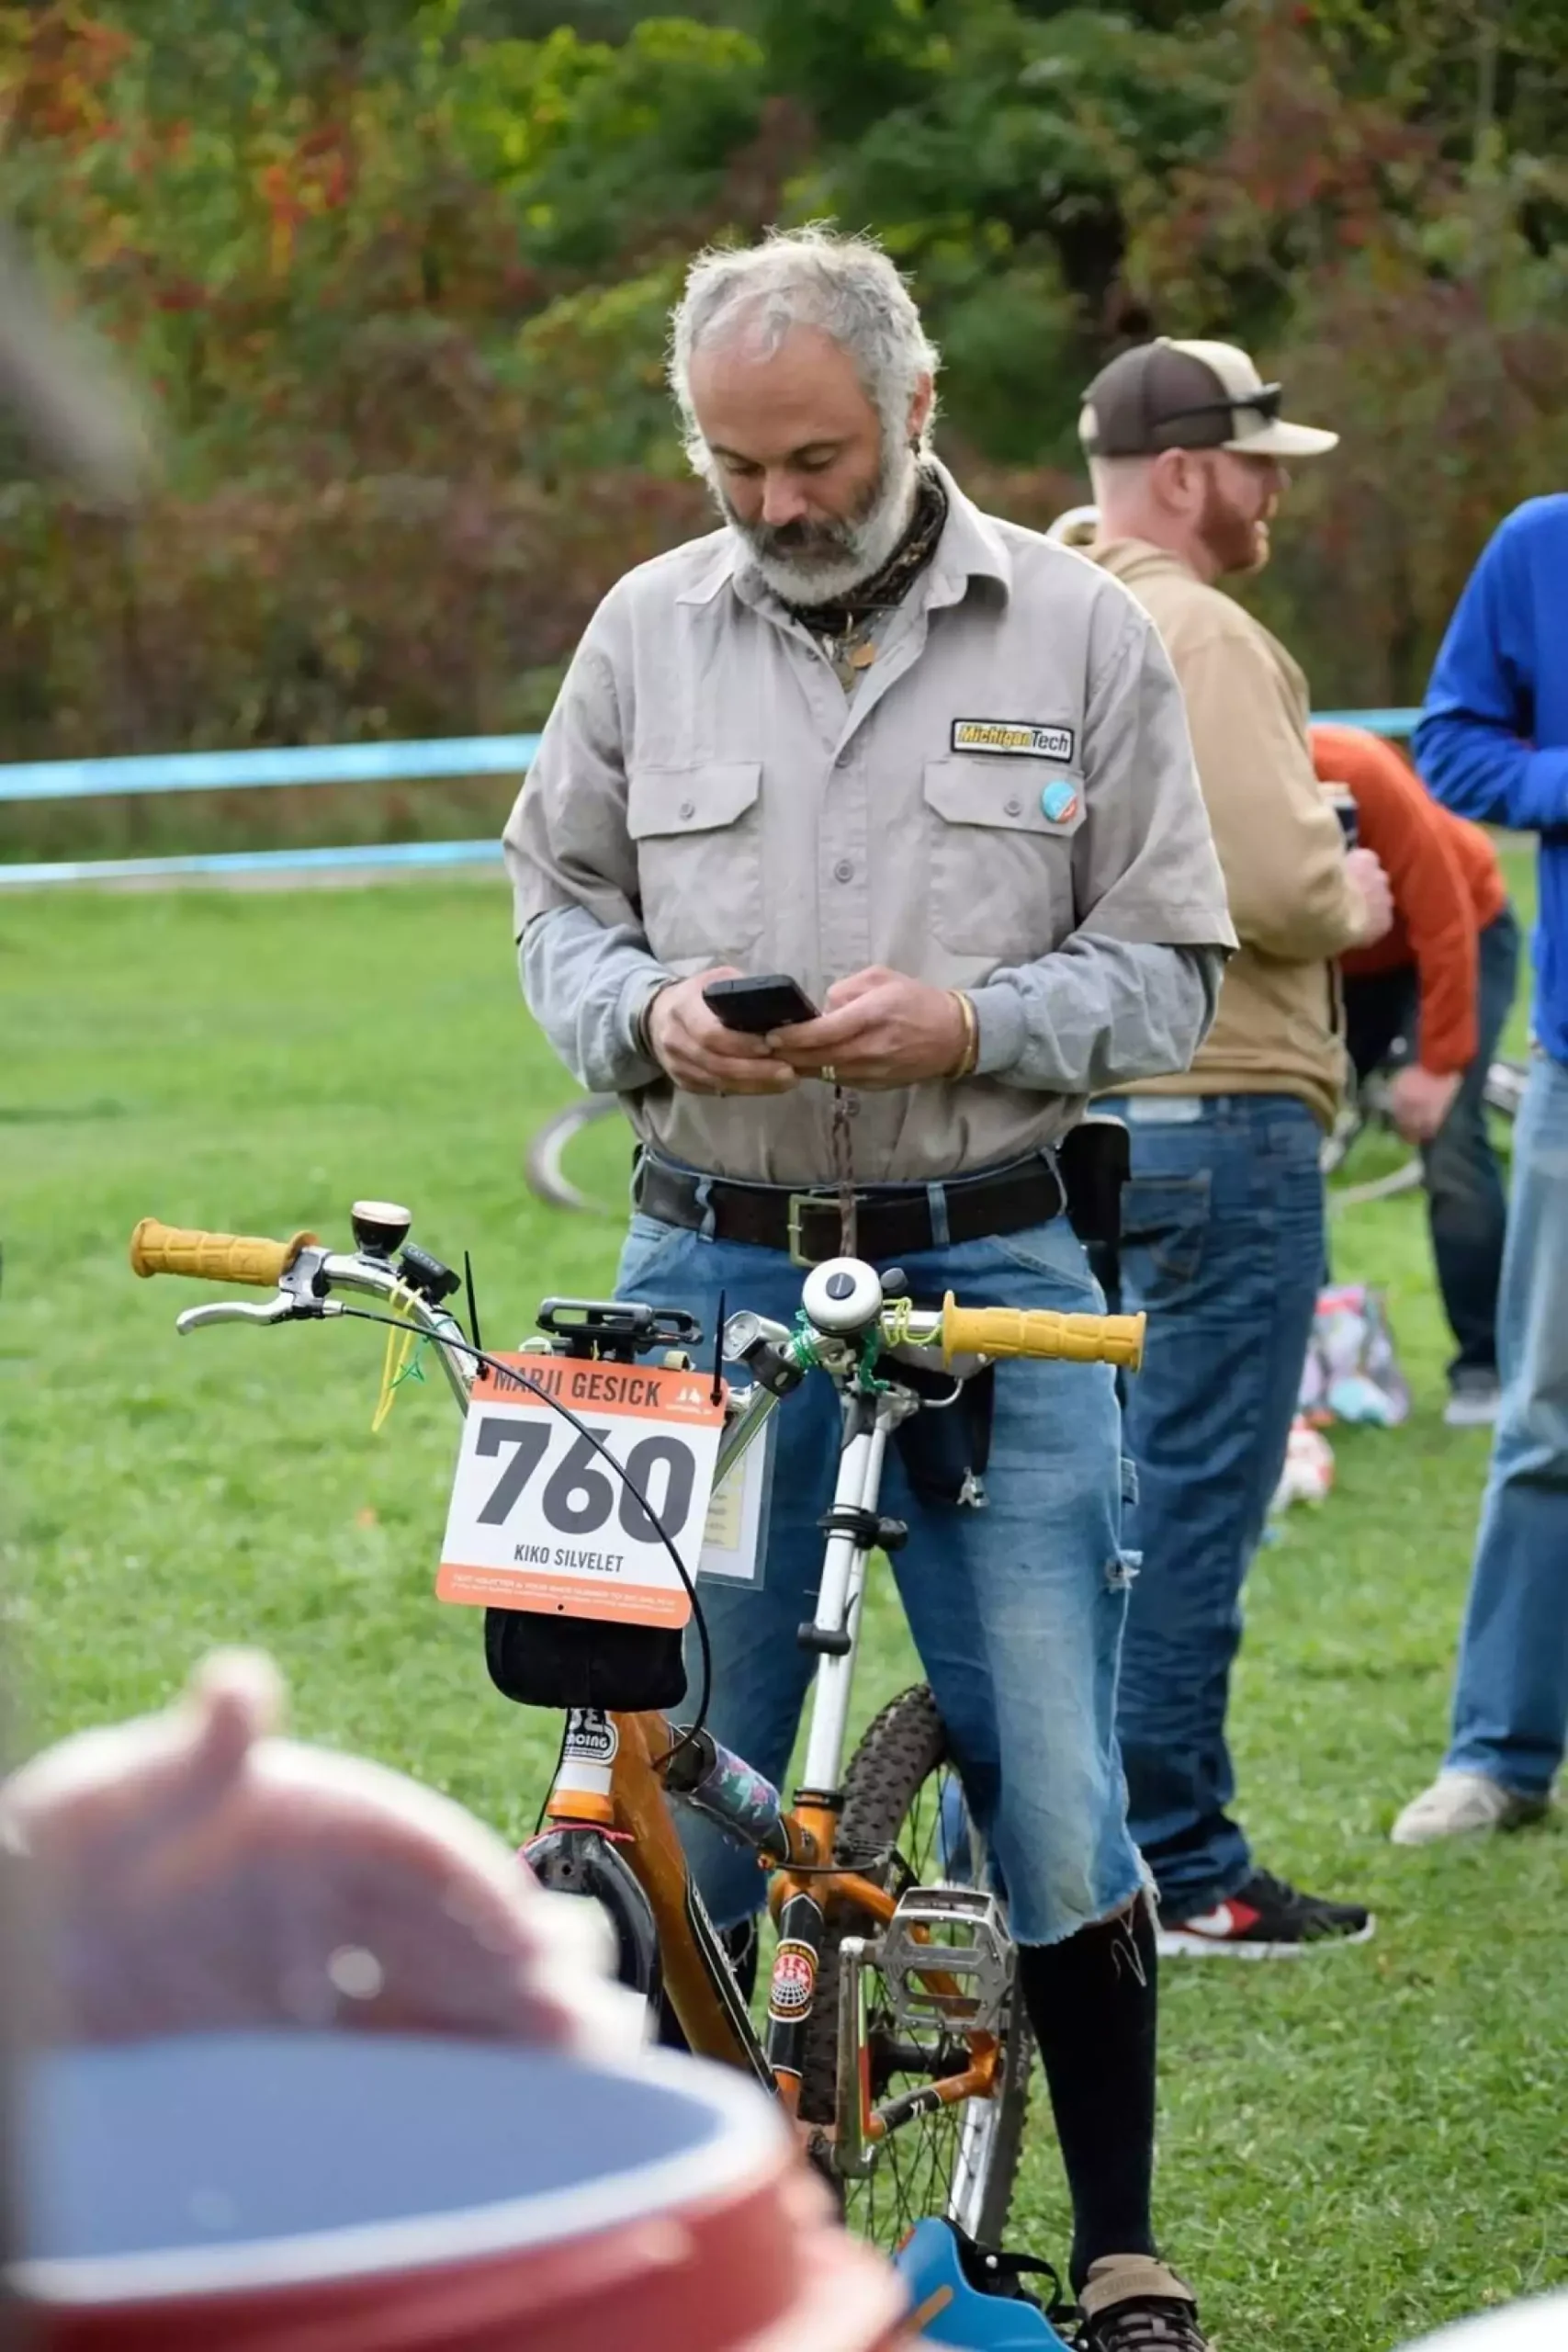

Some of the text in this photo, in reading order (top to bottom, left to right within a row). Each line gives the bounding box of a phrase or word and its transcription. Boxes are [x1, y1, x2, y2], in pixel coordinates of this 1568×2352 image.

[492, 1365, 662, 1408] MARJI GESICK
[475, 1417, 696, 1544] 760
[513, 1544, 625, 1573] KIKO SILVELET
